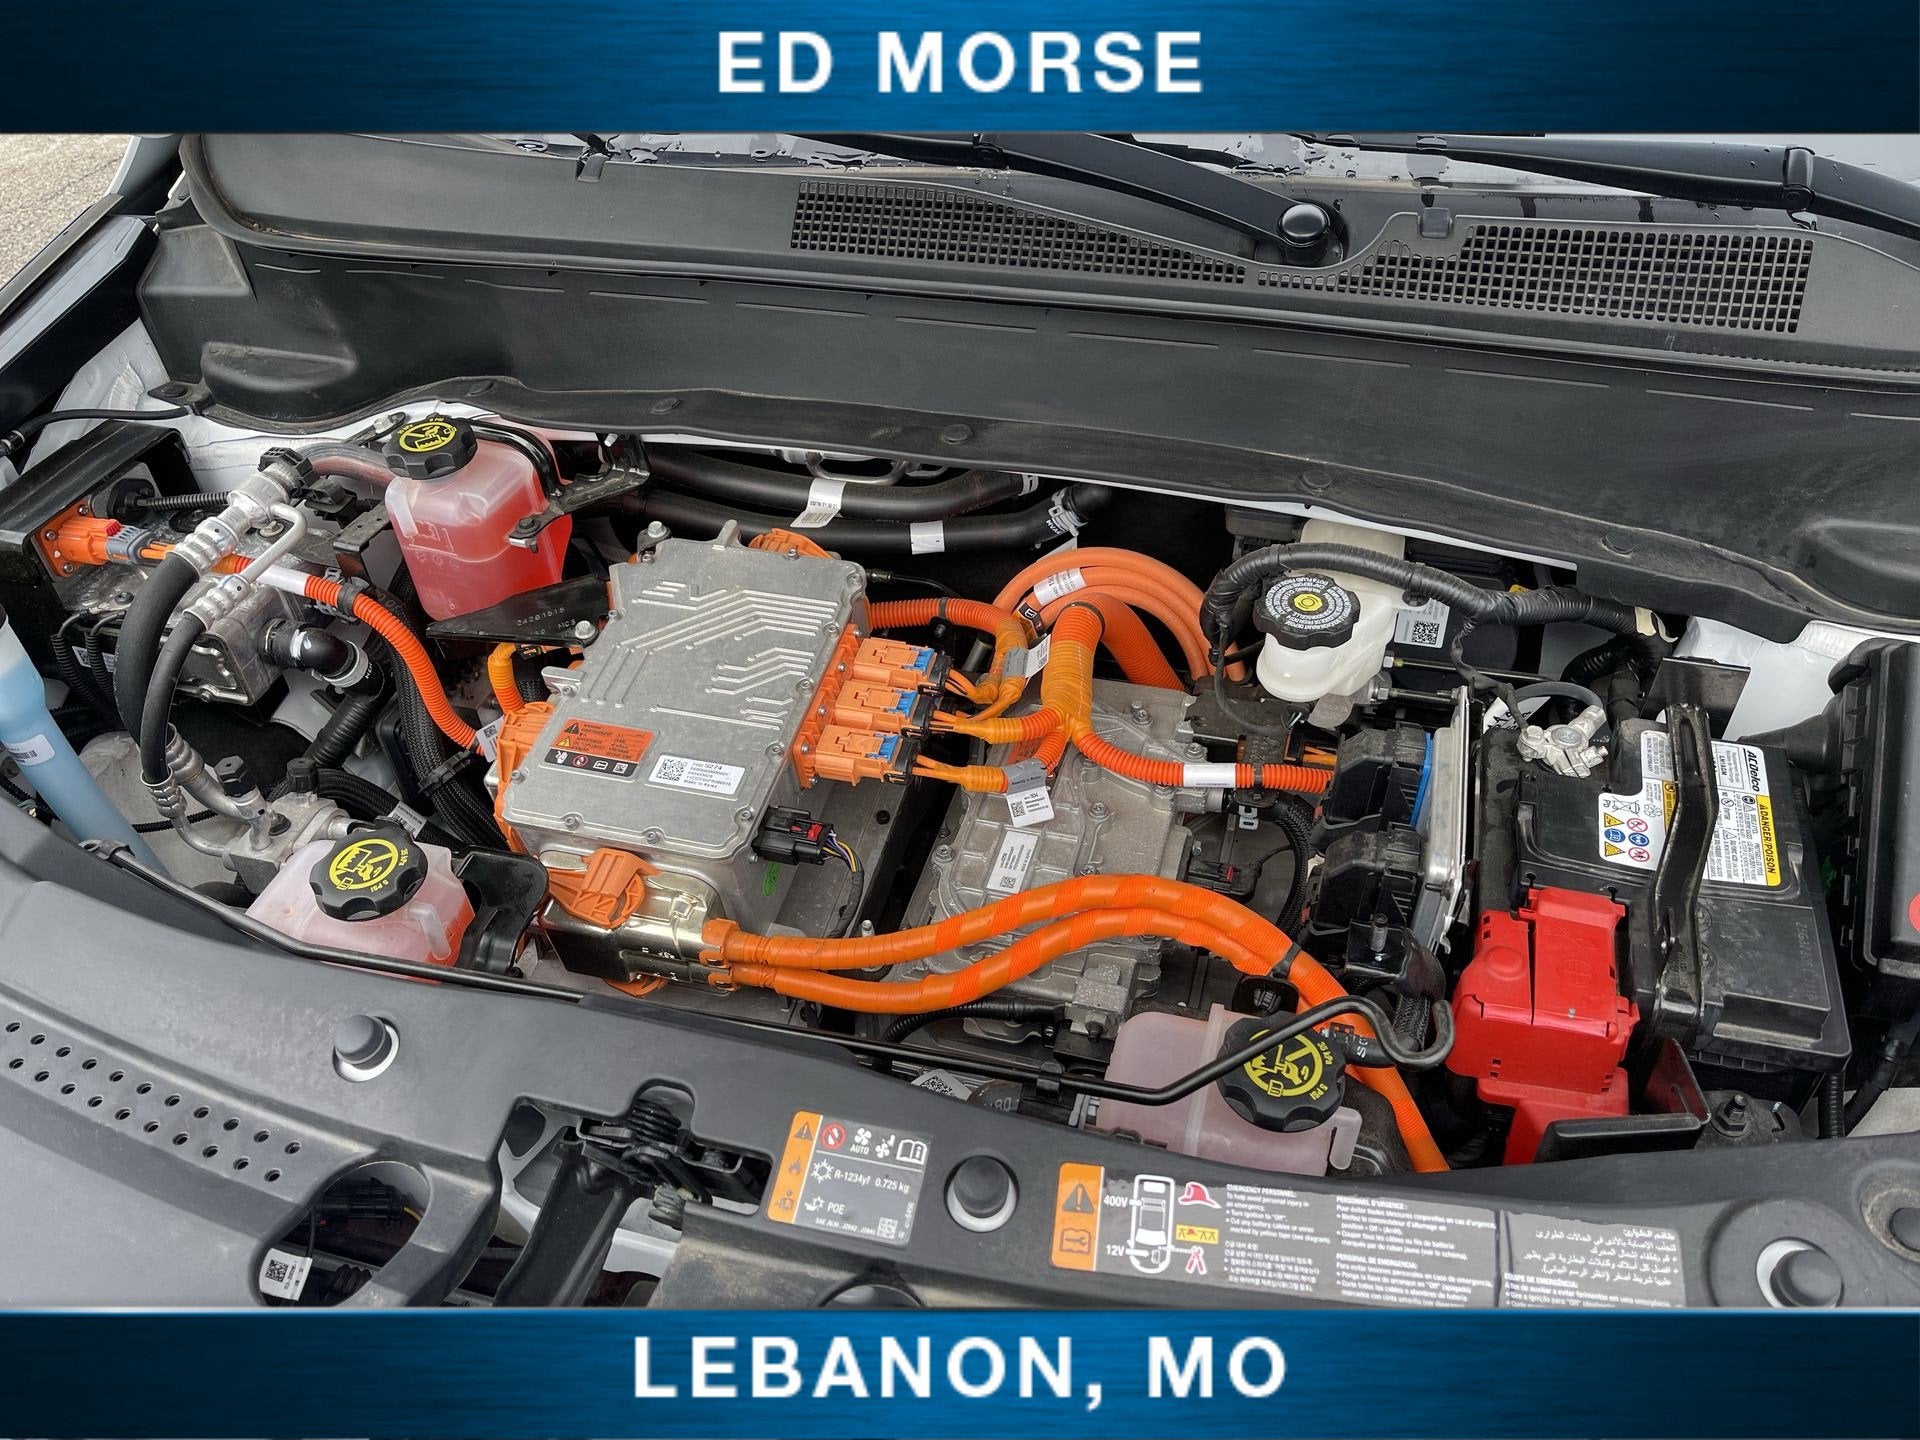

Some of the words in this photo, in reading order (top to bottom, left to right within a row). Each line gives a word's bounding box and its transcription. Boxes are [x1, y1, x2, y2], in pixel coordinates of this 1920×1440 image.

[1747, 751, 1760, 792] ACDelco
[1761, 810, 1776, 874] DANGER/POISON
[850, 1144, 869, 1155] AUTO
[834, 1169, 871, 1184] R-1234yf
[875, 1178, 898, 1191] 0.725
[898, 1182, 910, 1194] kg
[1104, 1195, 1128, 1208] 400V
[827, 1202, 846, 1215] POE
[1106, 1244, 1124, 1256] 12V
